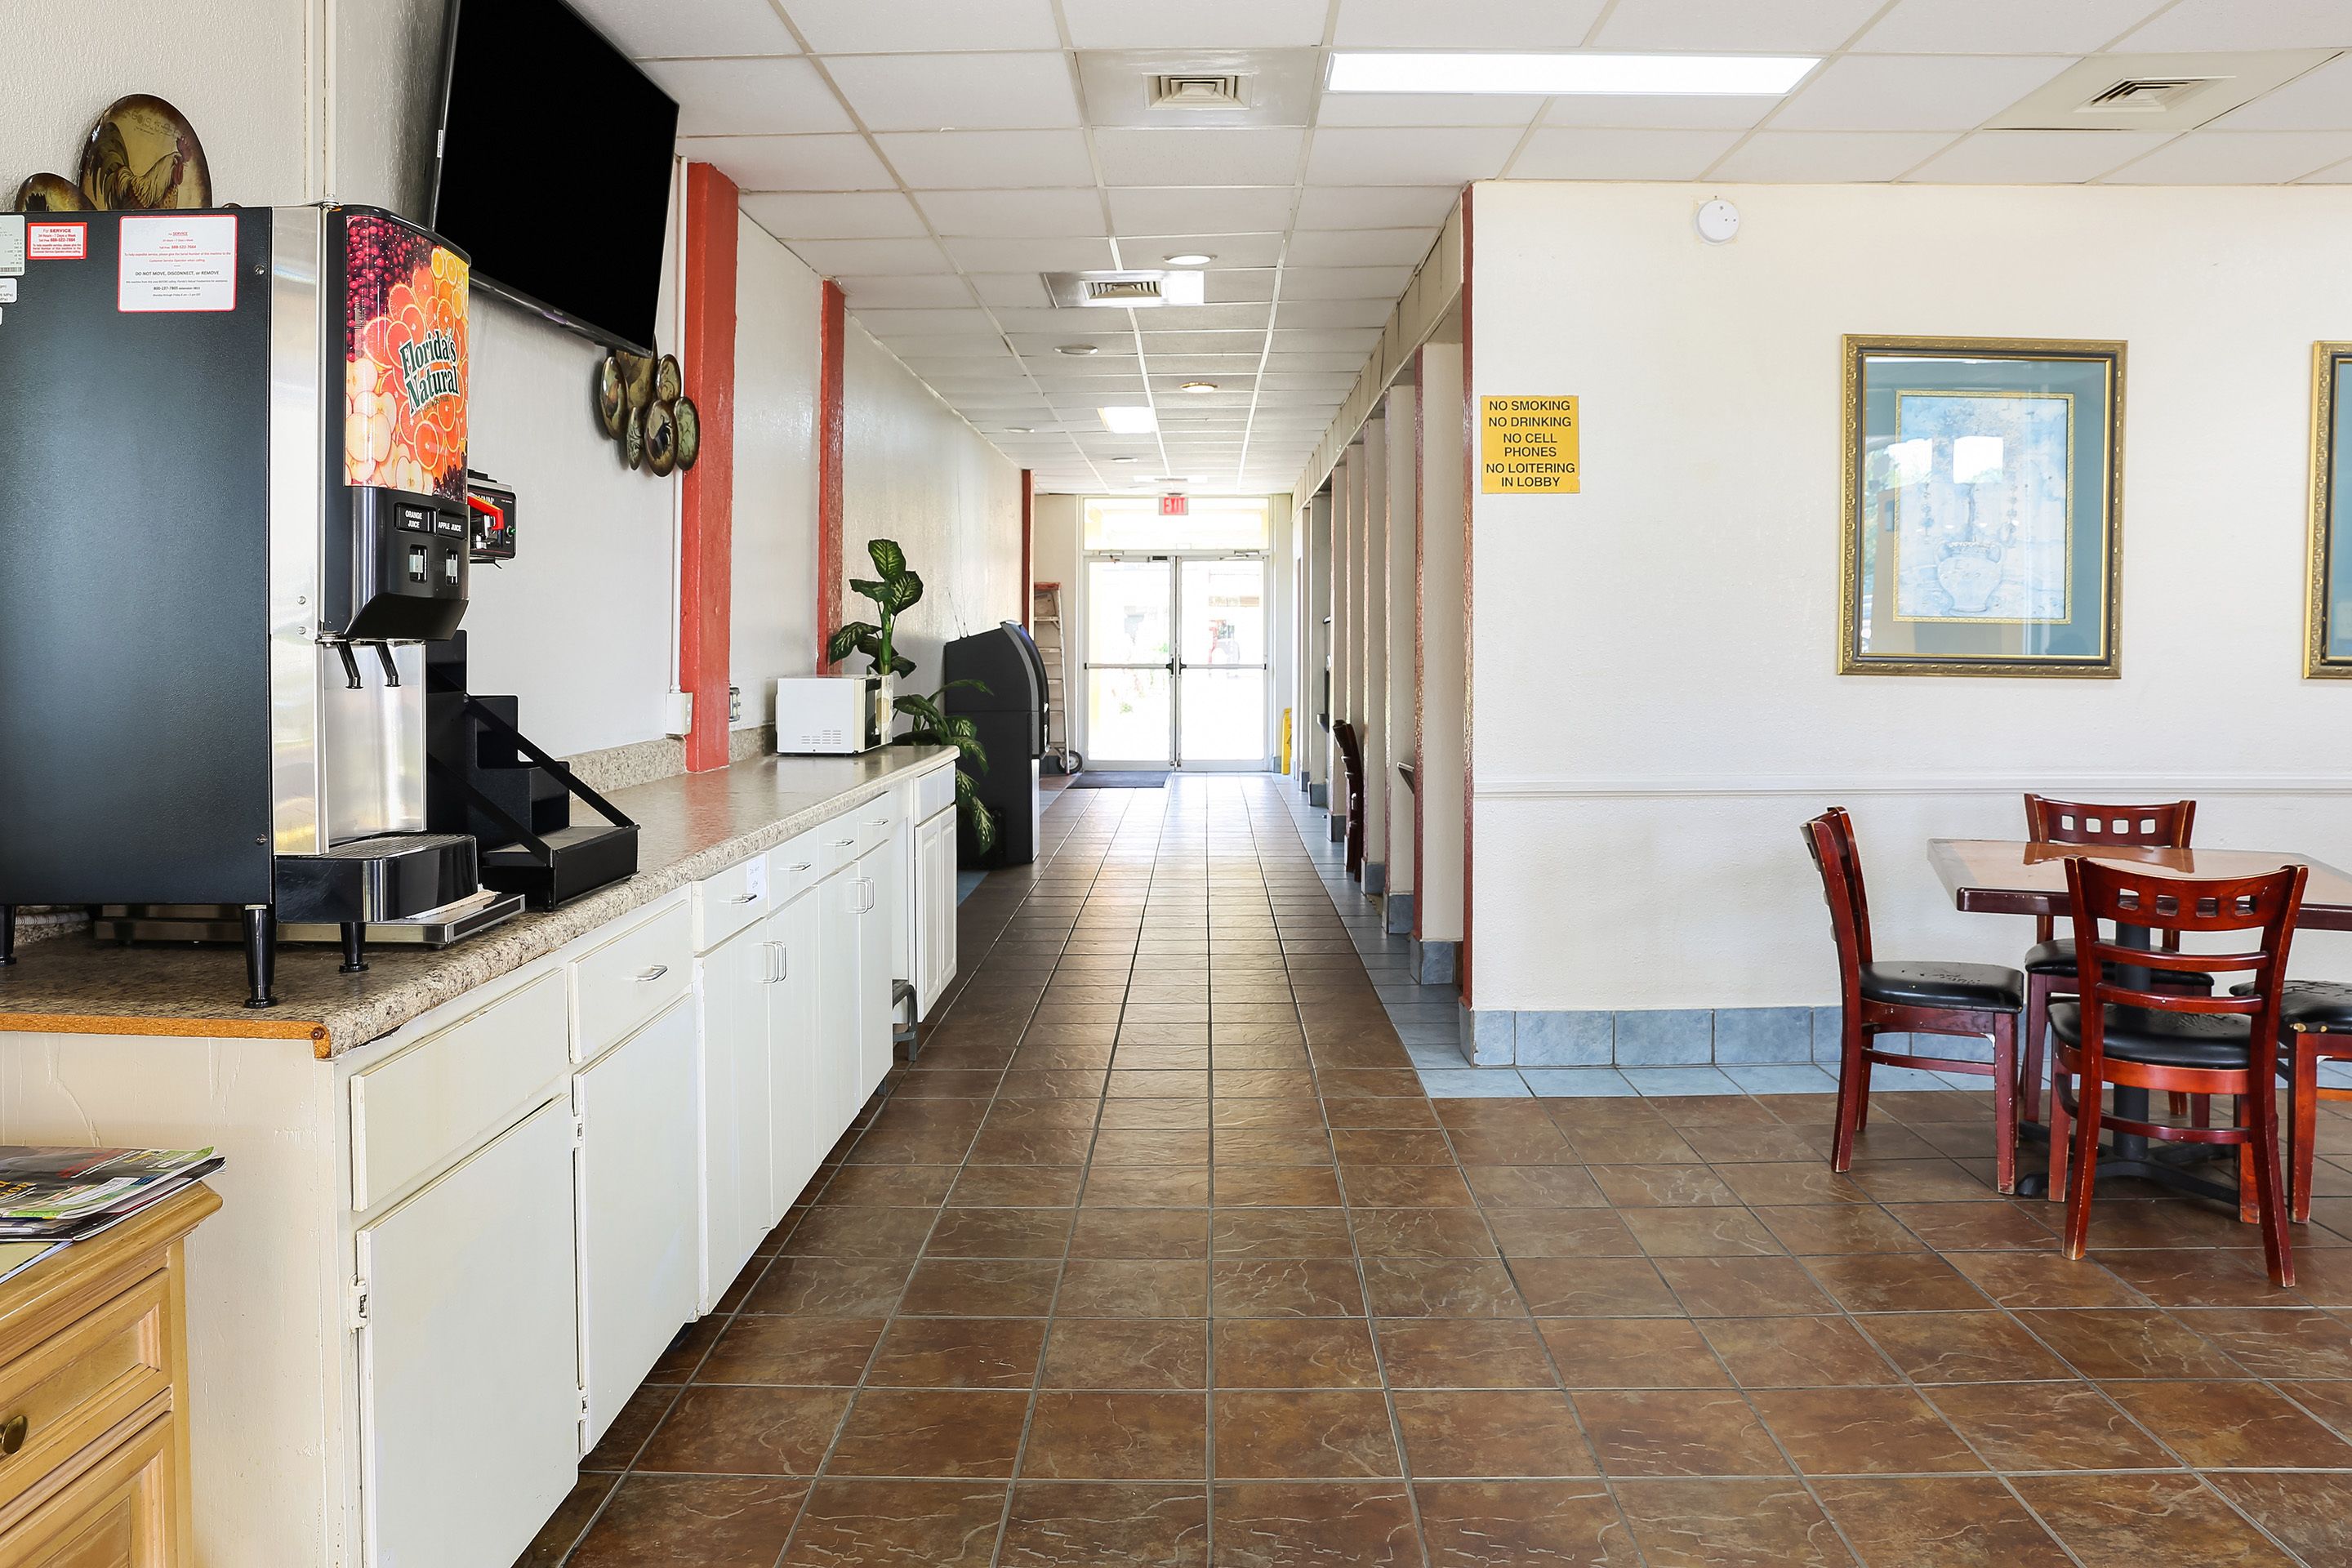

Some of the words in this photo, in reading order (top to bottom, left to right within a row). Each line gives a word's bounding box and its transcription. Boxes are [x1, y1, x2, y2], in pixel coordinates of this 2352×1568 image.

[400, 331, 456, 379] Florida's
[406, 366, 459, 414] Natural
[1490, 401, 1507, 411] NO
[1511, 401, 1570, 411] SMOKING
[1489, 417, 1507, 427] NO
[1511, 417, 1571, 427] DRINKING
[1503, 433, 1521, 443] NO
[1525, 433, 1557, 443] CELL
[1504, 447, 1556, 457] PHONES
[1486, 463, 1504, 473] NO
[1508, 463, 1575, 473] LOITERING
[1502, 477, 1513, 487] IN
[1517, 477, 1560, 487] LOBBY
[1163, 497, 1185, 514] EXIT
[405, 510, 423, 519] ORANGE
[408, 520, 420, 528] JUICE
[438, 521, 450, 530] APPLE
